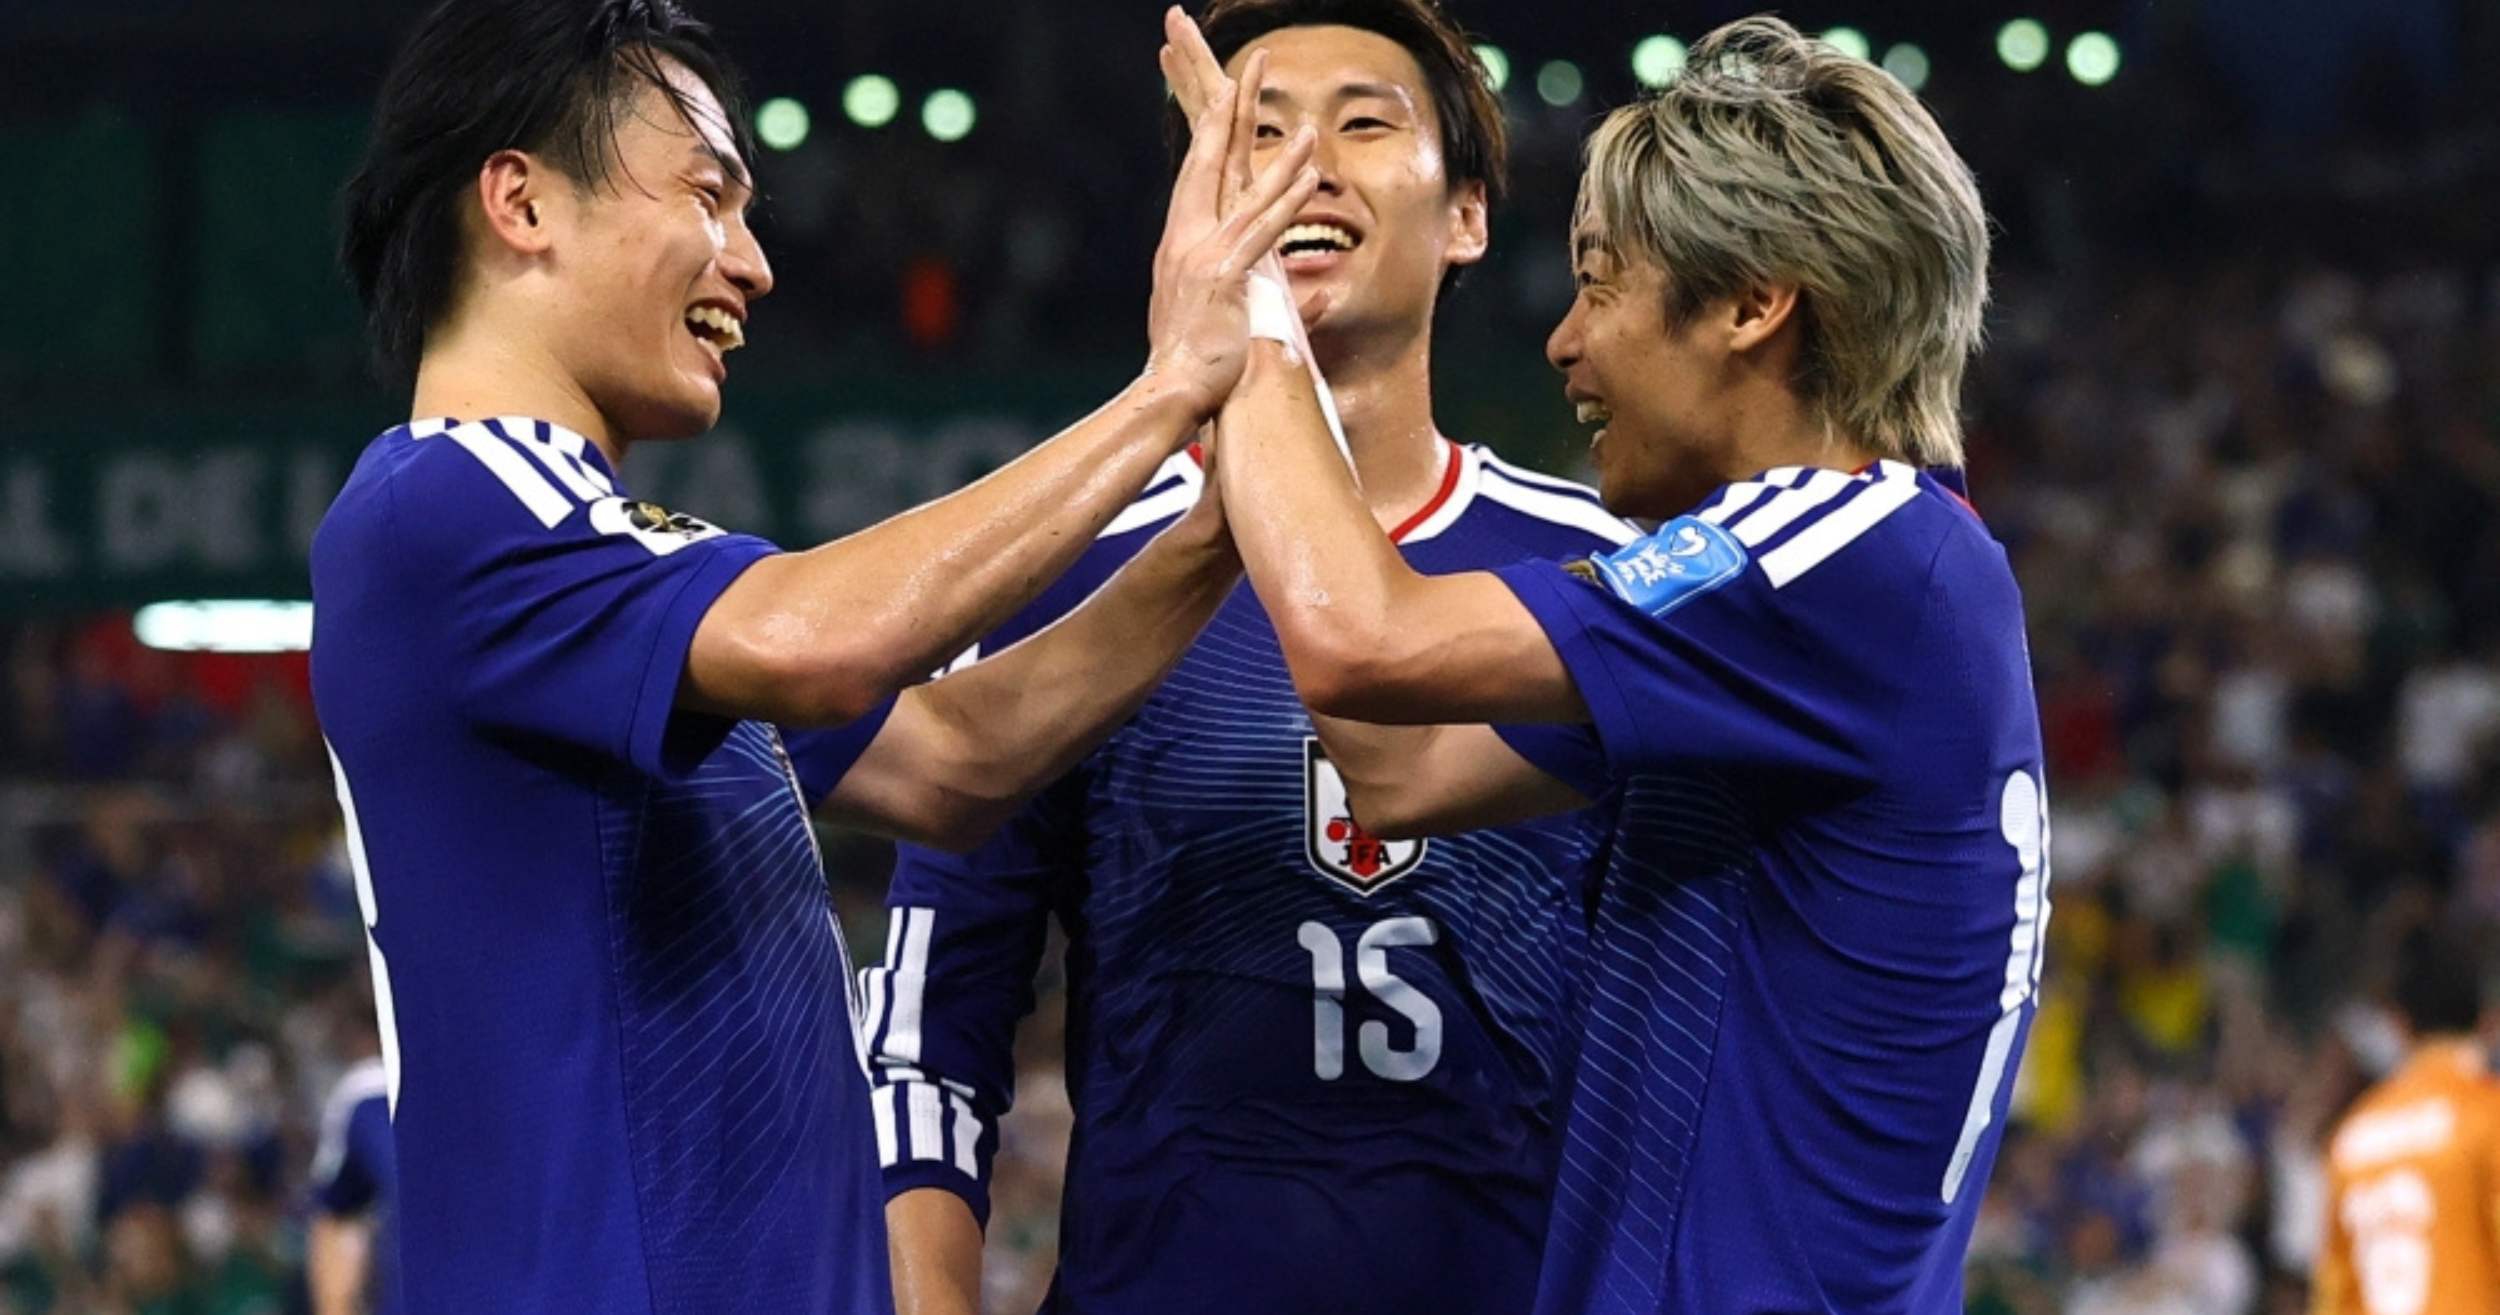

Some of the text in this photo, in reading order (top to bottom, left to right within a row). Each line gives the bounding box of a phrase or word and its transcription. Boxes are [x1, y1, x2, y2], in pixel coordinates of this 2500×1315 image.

[1338, 843, 1393, 867] JFA
[1297, 916, 1443, 1082] 15
[1942, 769, 2051, 1204] 1
